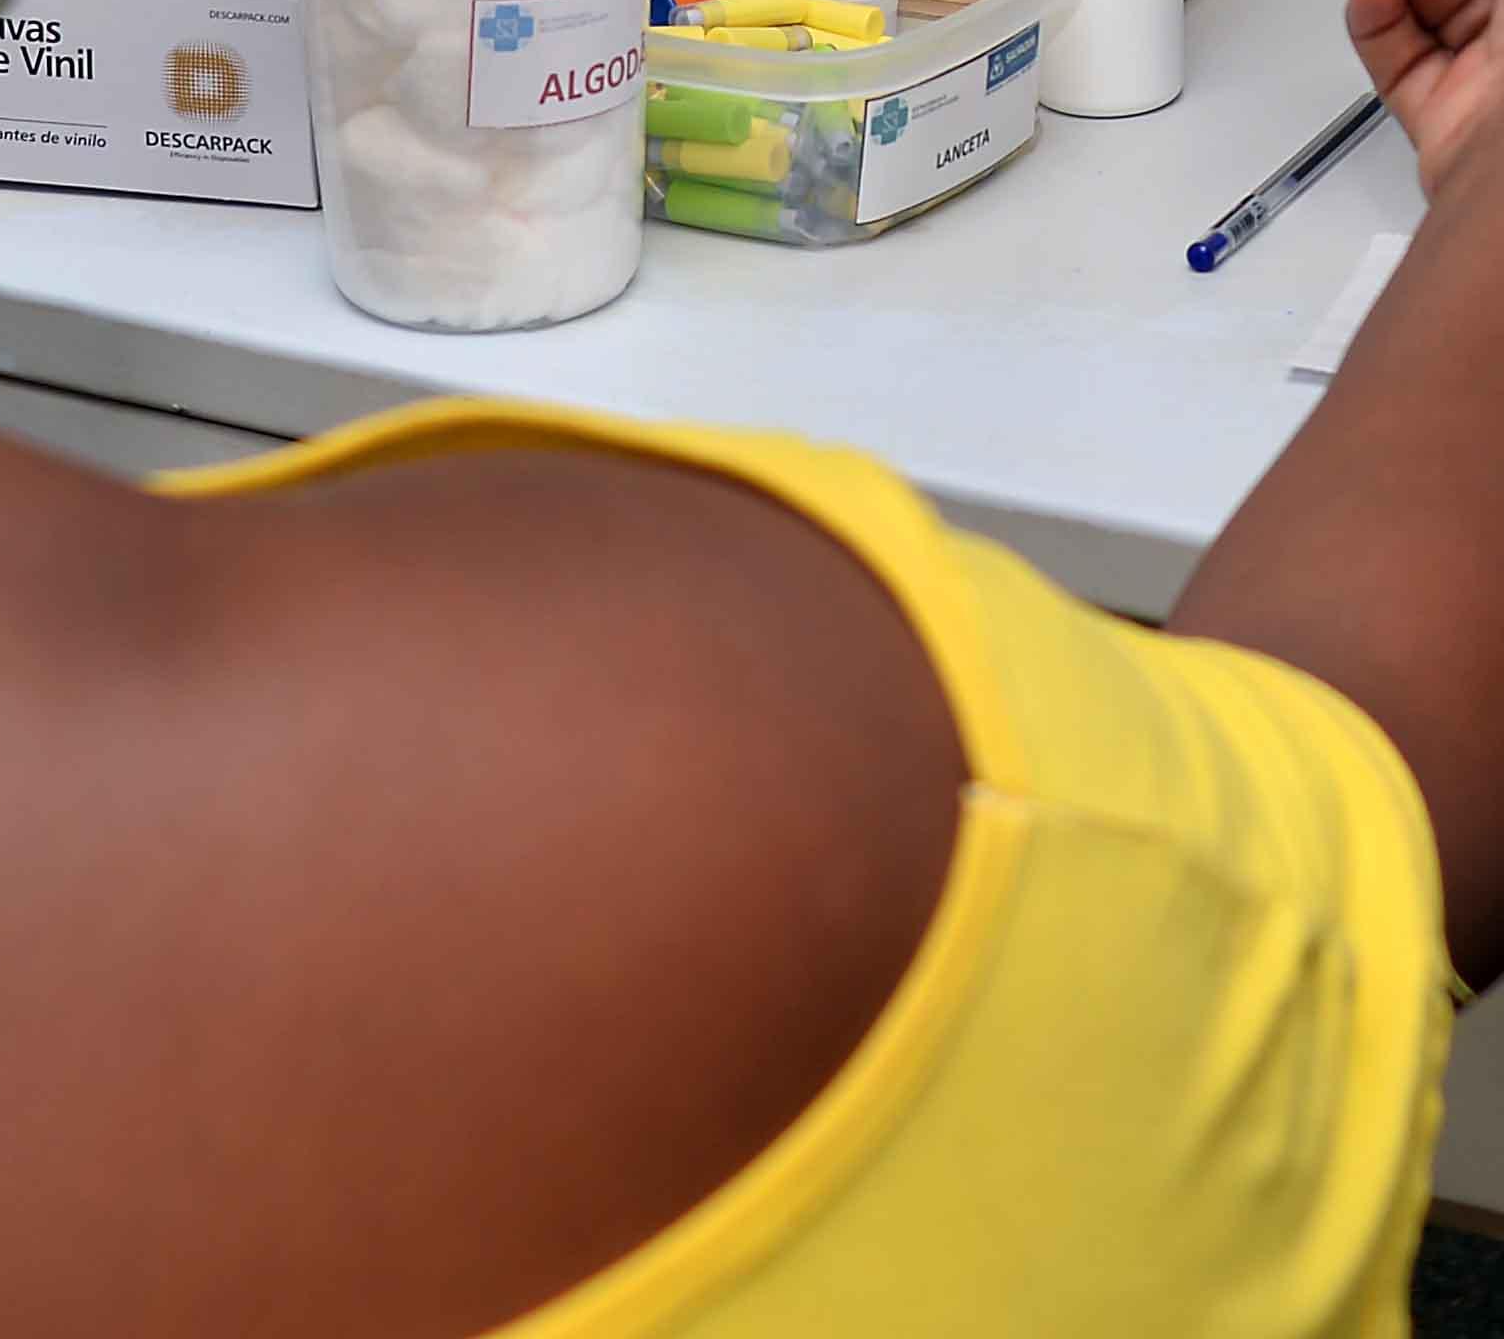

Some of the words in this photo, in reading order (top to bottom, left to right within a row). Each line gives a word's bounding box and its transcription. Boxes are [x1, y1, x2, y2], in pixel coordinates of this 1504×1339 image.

[208, 9, 291, 25] DESCARPACK.COM
[20, 45, 94, 81] Vinil
[40, 130, 61, 146] de
[64, 132, 108, 149] vinilo
[145, 130, 274, 156] DESCARPACK
[936, 128, 991, 170] LANCETA
